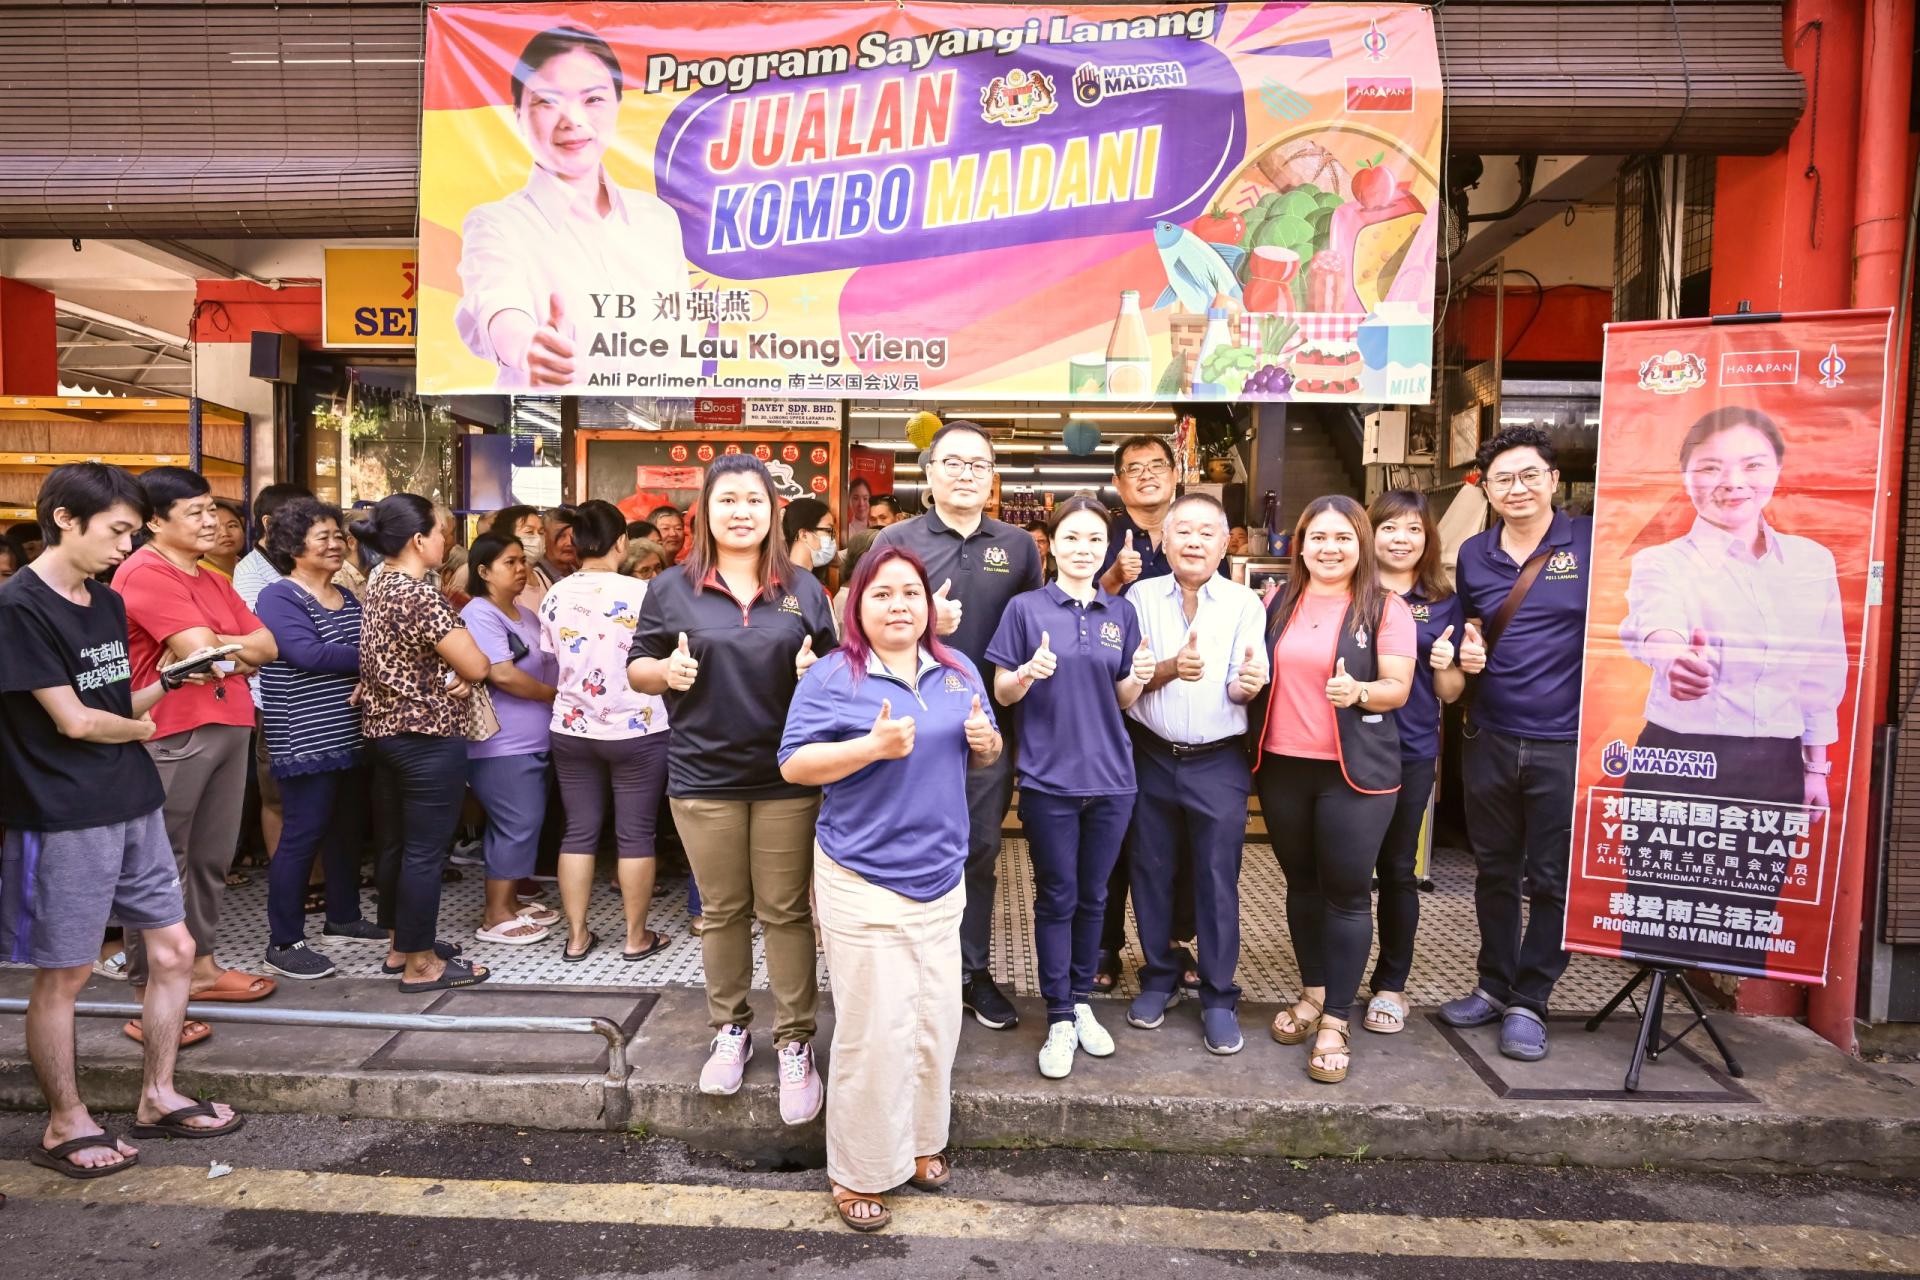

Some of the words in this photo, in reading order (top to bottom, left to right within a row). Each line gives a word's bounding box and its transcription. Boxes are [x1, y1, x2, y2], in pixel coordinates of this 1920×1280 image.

[645, 45, 849, 93] Program
[856, 19, 1040, 71] Sayangi
[1049, 7, 1216, 45] Lanang
[1103, 62, 1181, 78] MALAYSIA
[1105, 71, 1184, 94] MADANI
[1355, 86, 1405, 98] HARAPAN
[707, 70, 956, 173] JUALAN
[707, 164, 914, 254] KOMBO
[922, 125, 1162, 229] MADANI
[589, 293, 636, 319] YB
[652, 290, 751, 322] 刘强燕
[589, 332, 669, 358] Alice
[681, 334, 738, 359] Lau
[750, 333, 840, 366] Kiong
[849, 333, 946, 365] Yieng
[1727, 363, 1793, 374] HARAPAN
[588, 373, 620, 387] Ahli
[627, 373, 707, 388] Parlimen
[712, 375, 782, 391] Lanang
[788, 373, 919, 391] 南兰区国会议员
[1390, 376, 1426, 395] MILK
[752, 404, 784, 412] DAYET
[788, 404, 810, 413] SDN.
[813, 404, 836, 413] BHD.
[573, 603, 592, 617] LOVE
[1631, 758, 1715, 777] MADANI
[1633, 748, 1714, 763] MALAYSIA
[1602, 795, 1810, 838] 刘强燕国会议员
[1601, 823, 1639, 841] YB
[1648, 828, 1737, 851] ALICE
[1747, 836, 1810, 858] LAU
[1597, 856, 1633, 866] AHLI
[1643, 859, 1726, 876] PARLIMEN
[1735, 870, 1807, 886] LANANG
[1622, 868, 1654, 878] PUSAT
[1656, 872, 1701, 883] KHIDMAT
[1703, 877, 1728, 887] P.211
[1731, 880, 1776, 892] LANANG
[1609, 892, 1784, 935] 我爱南兰活动
[1592, 916, 1664, 937] PROGRAM
[1668, 925, 1733, 946] SAYANGI
[1735, 933, 1796, 955] LANANG
